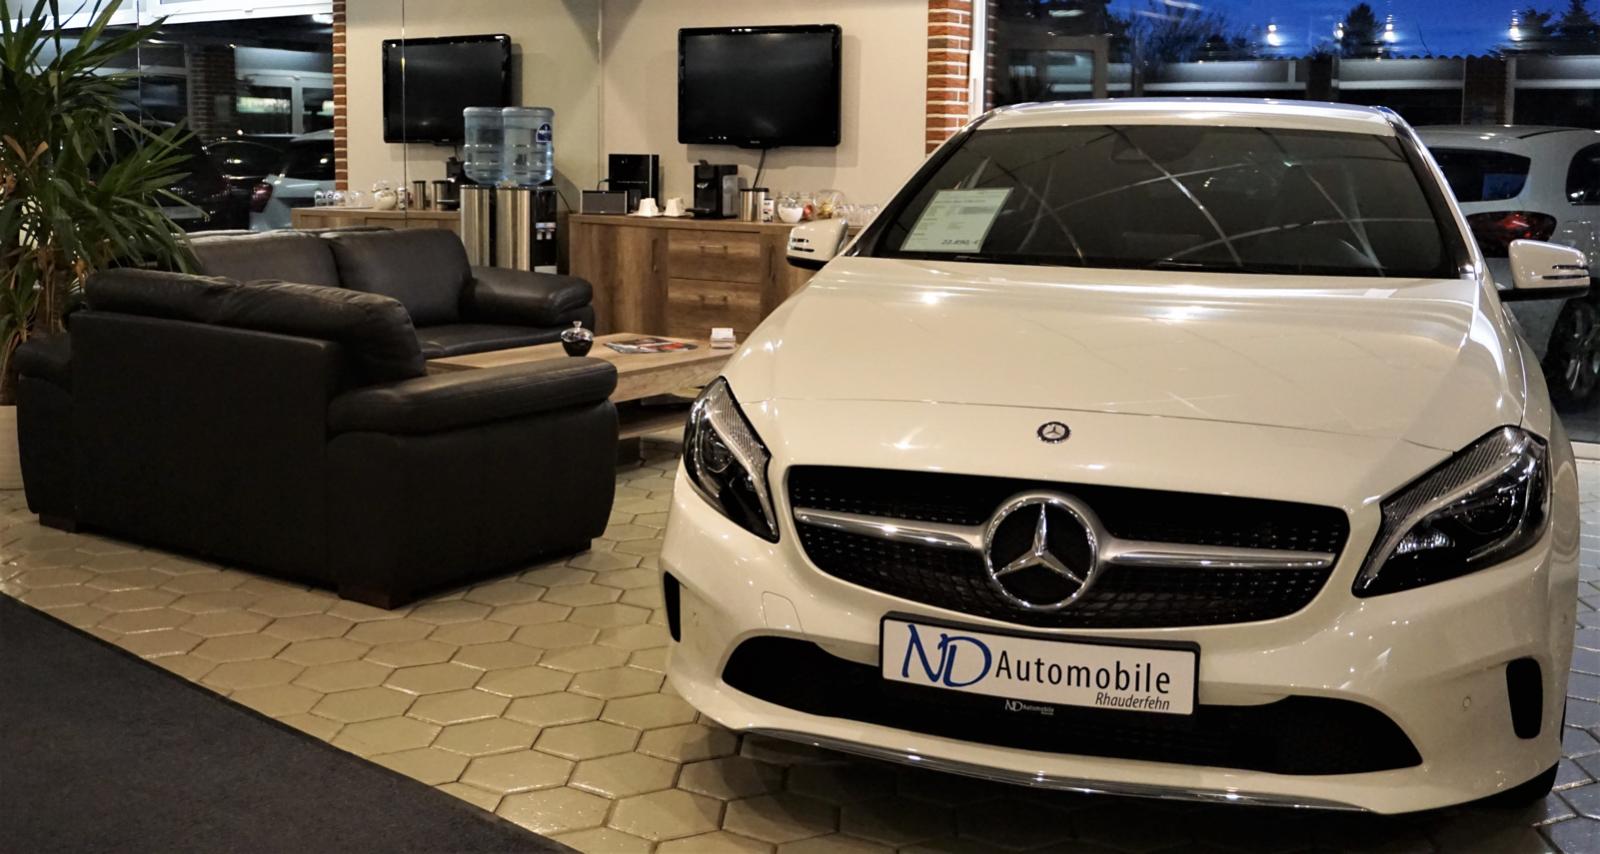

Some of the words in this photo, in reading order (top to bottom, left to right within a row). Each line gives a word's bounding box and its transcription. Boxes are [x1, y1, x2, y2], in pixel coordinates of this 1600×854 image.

[902, 624, 992, 687] ND
[996, 650, 1171, 694] Automobile
[1005, 699, 1023, 712] ND
[1095, 691, 1170, 711] Rhauderfehn
